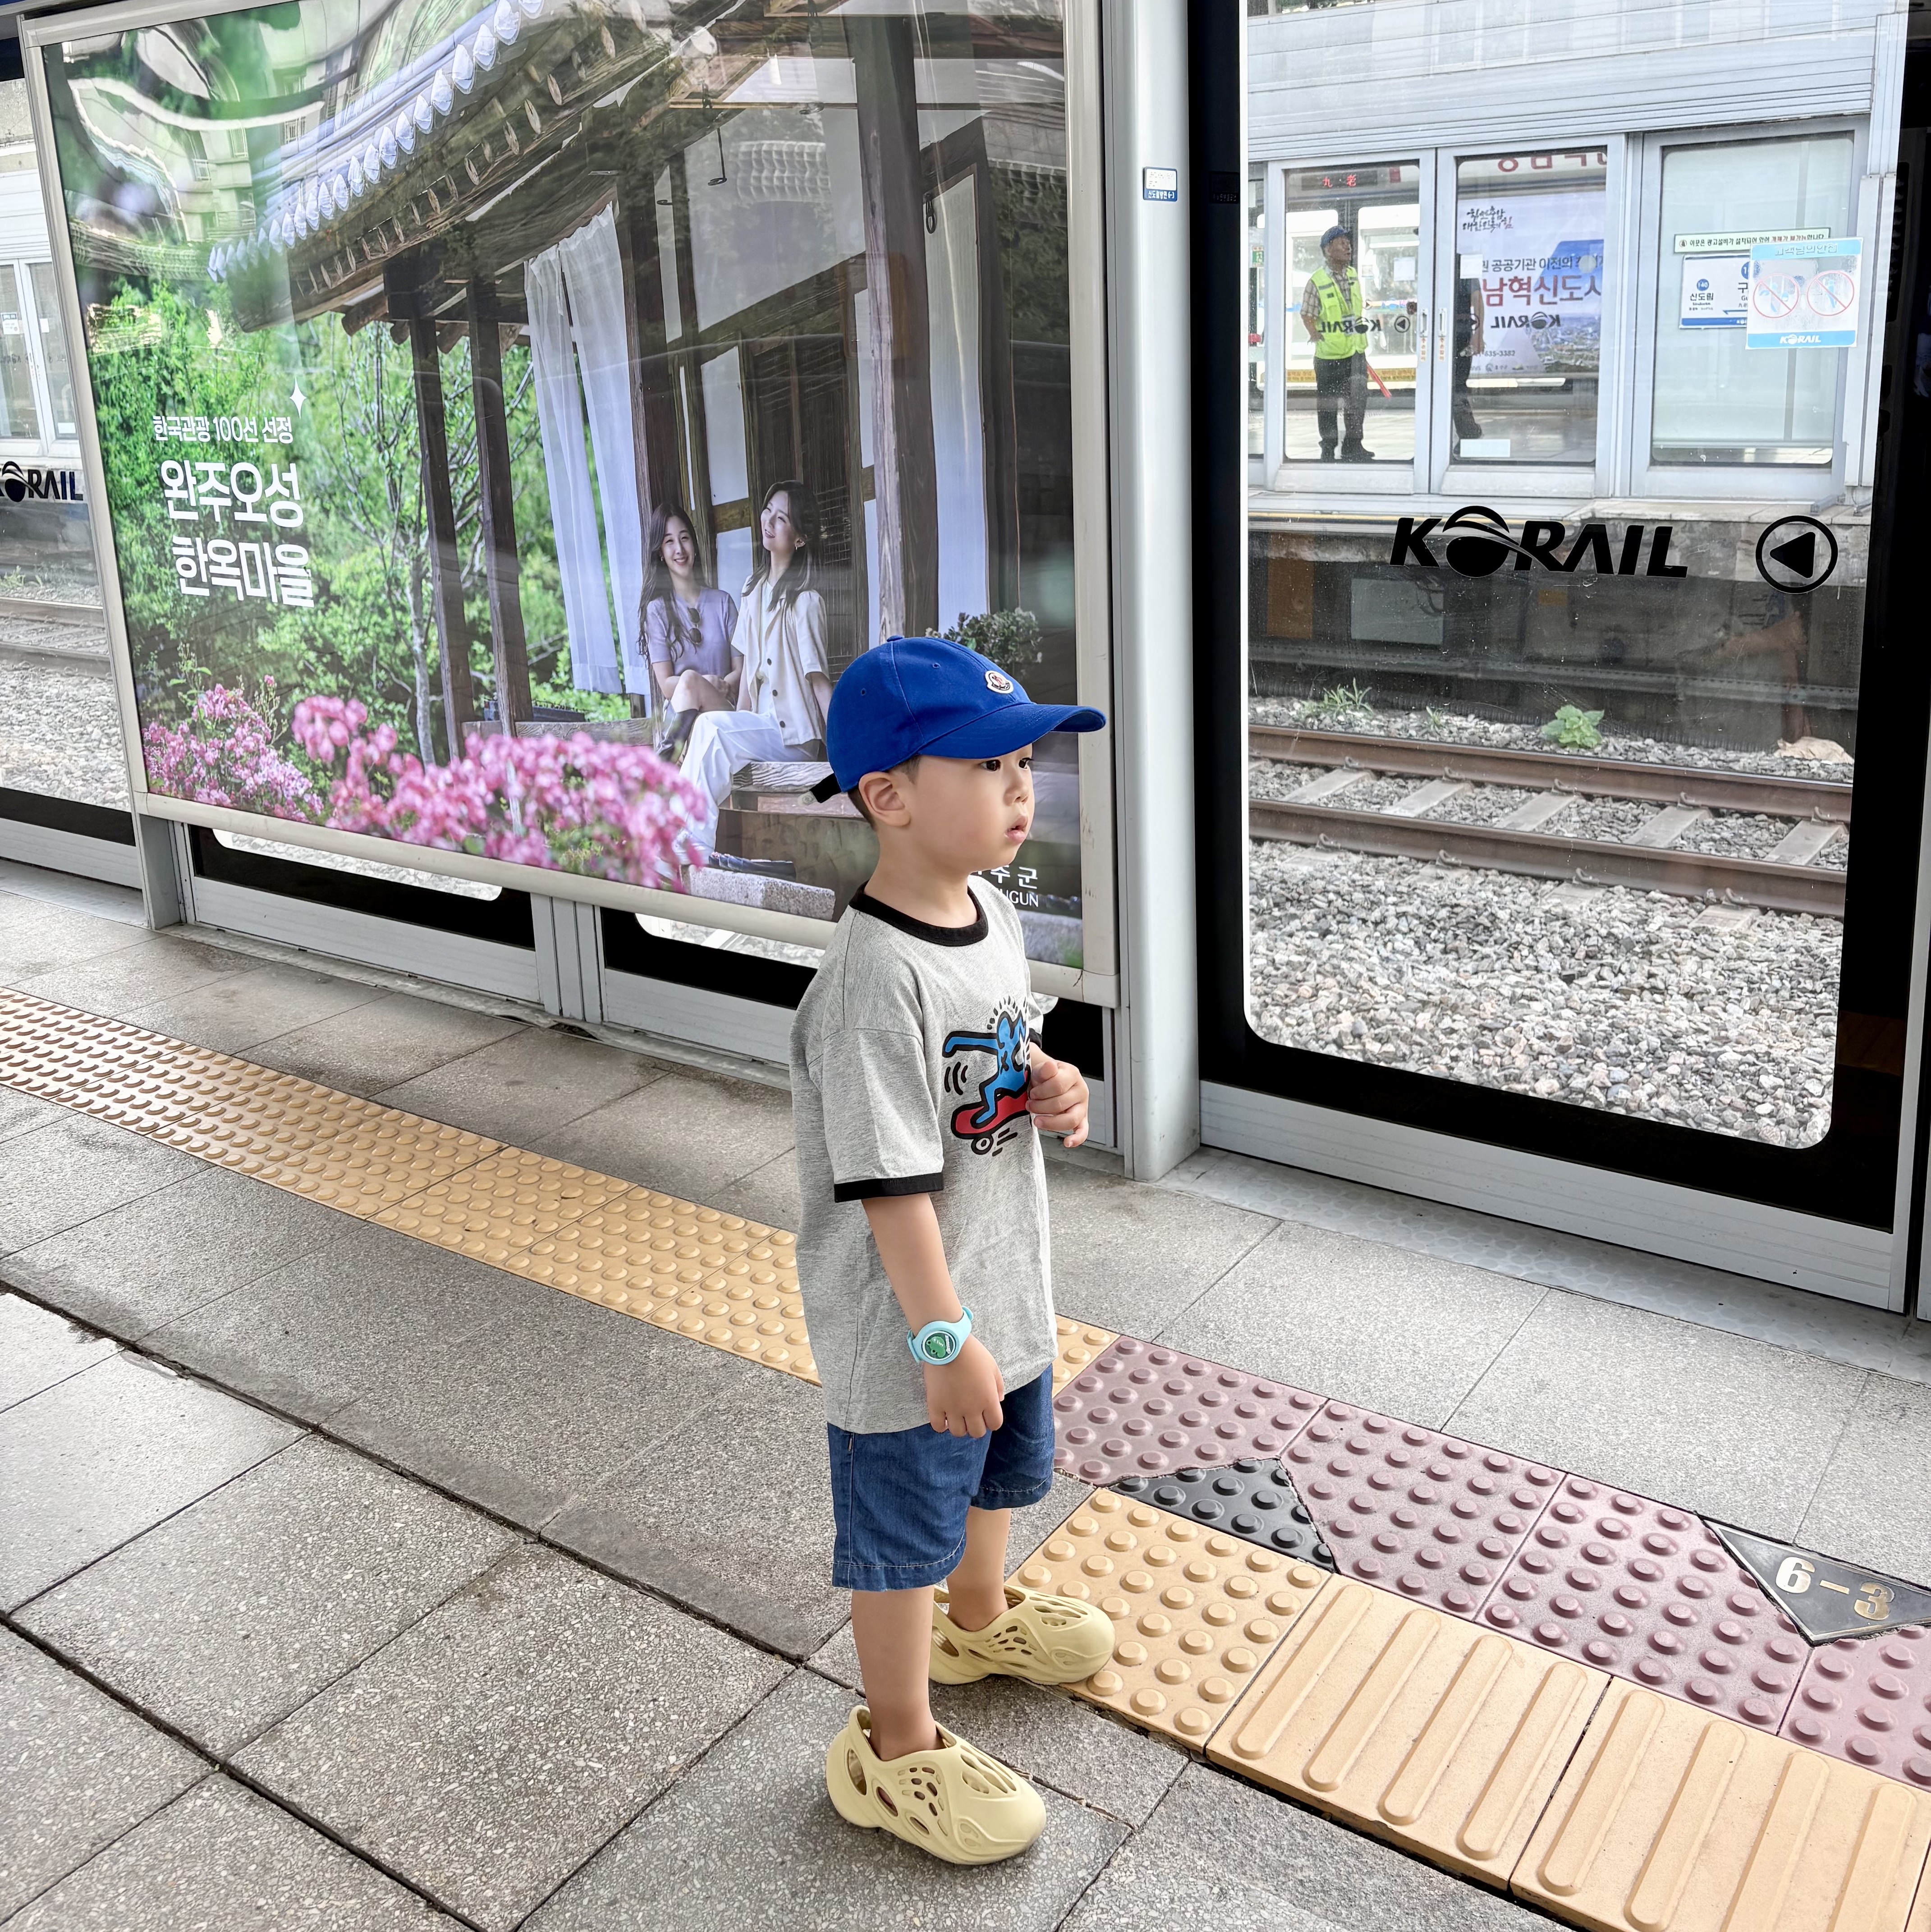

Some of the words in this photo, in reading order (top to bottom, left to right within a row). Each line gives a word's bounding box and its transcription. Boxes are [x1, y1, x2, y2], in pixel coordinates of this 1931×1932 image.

[1491, 258, 1537, 272] 공공기관
[1539, 255, 1573, 270] 이전의
[1690, 293, 1714, 301] 신도림
[1780, 334, 1822, 345] KORAIL
[153, 415, 210, 443] 한국관광
[213, 416, 259, 443] 100선
[261, 416, 294, 444] 선정
[0, 461, 84, 502] ORAIL
[161, 459, 304, 528] 완주오성
[1390, 505, 1688, 578] KORAIL
[172, 535, 314, 608] 한옥마을
[1775, 1556, 1895, 1620] 6-3
